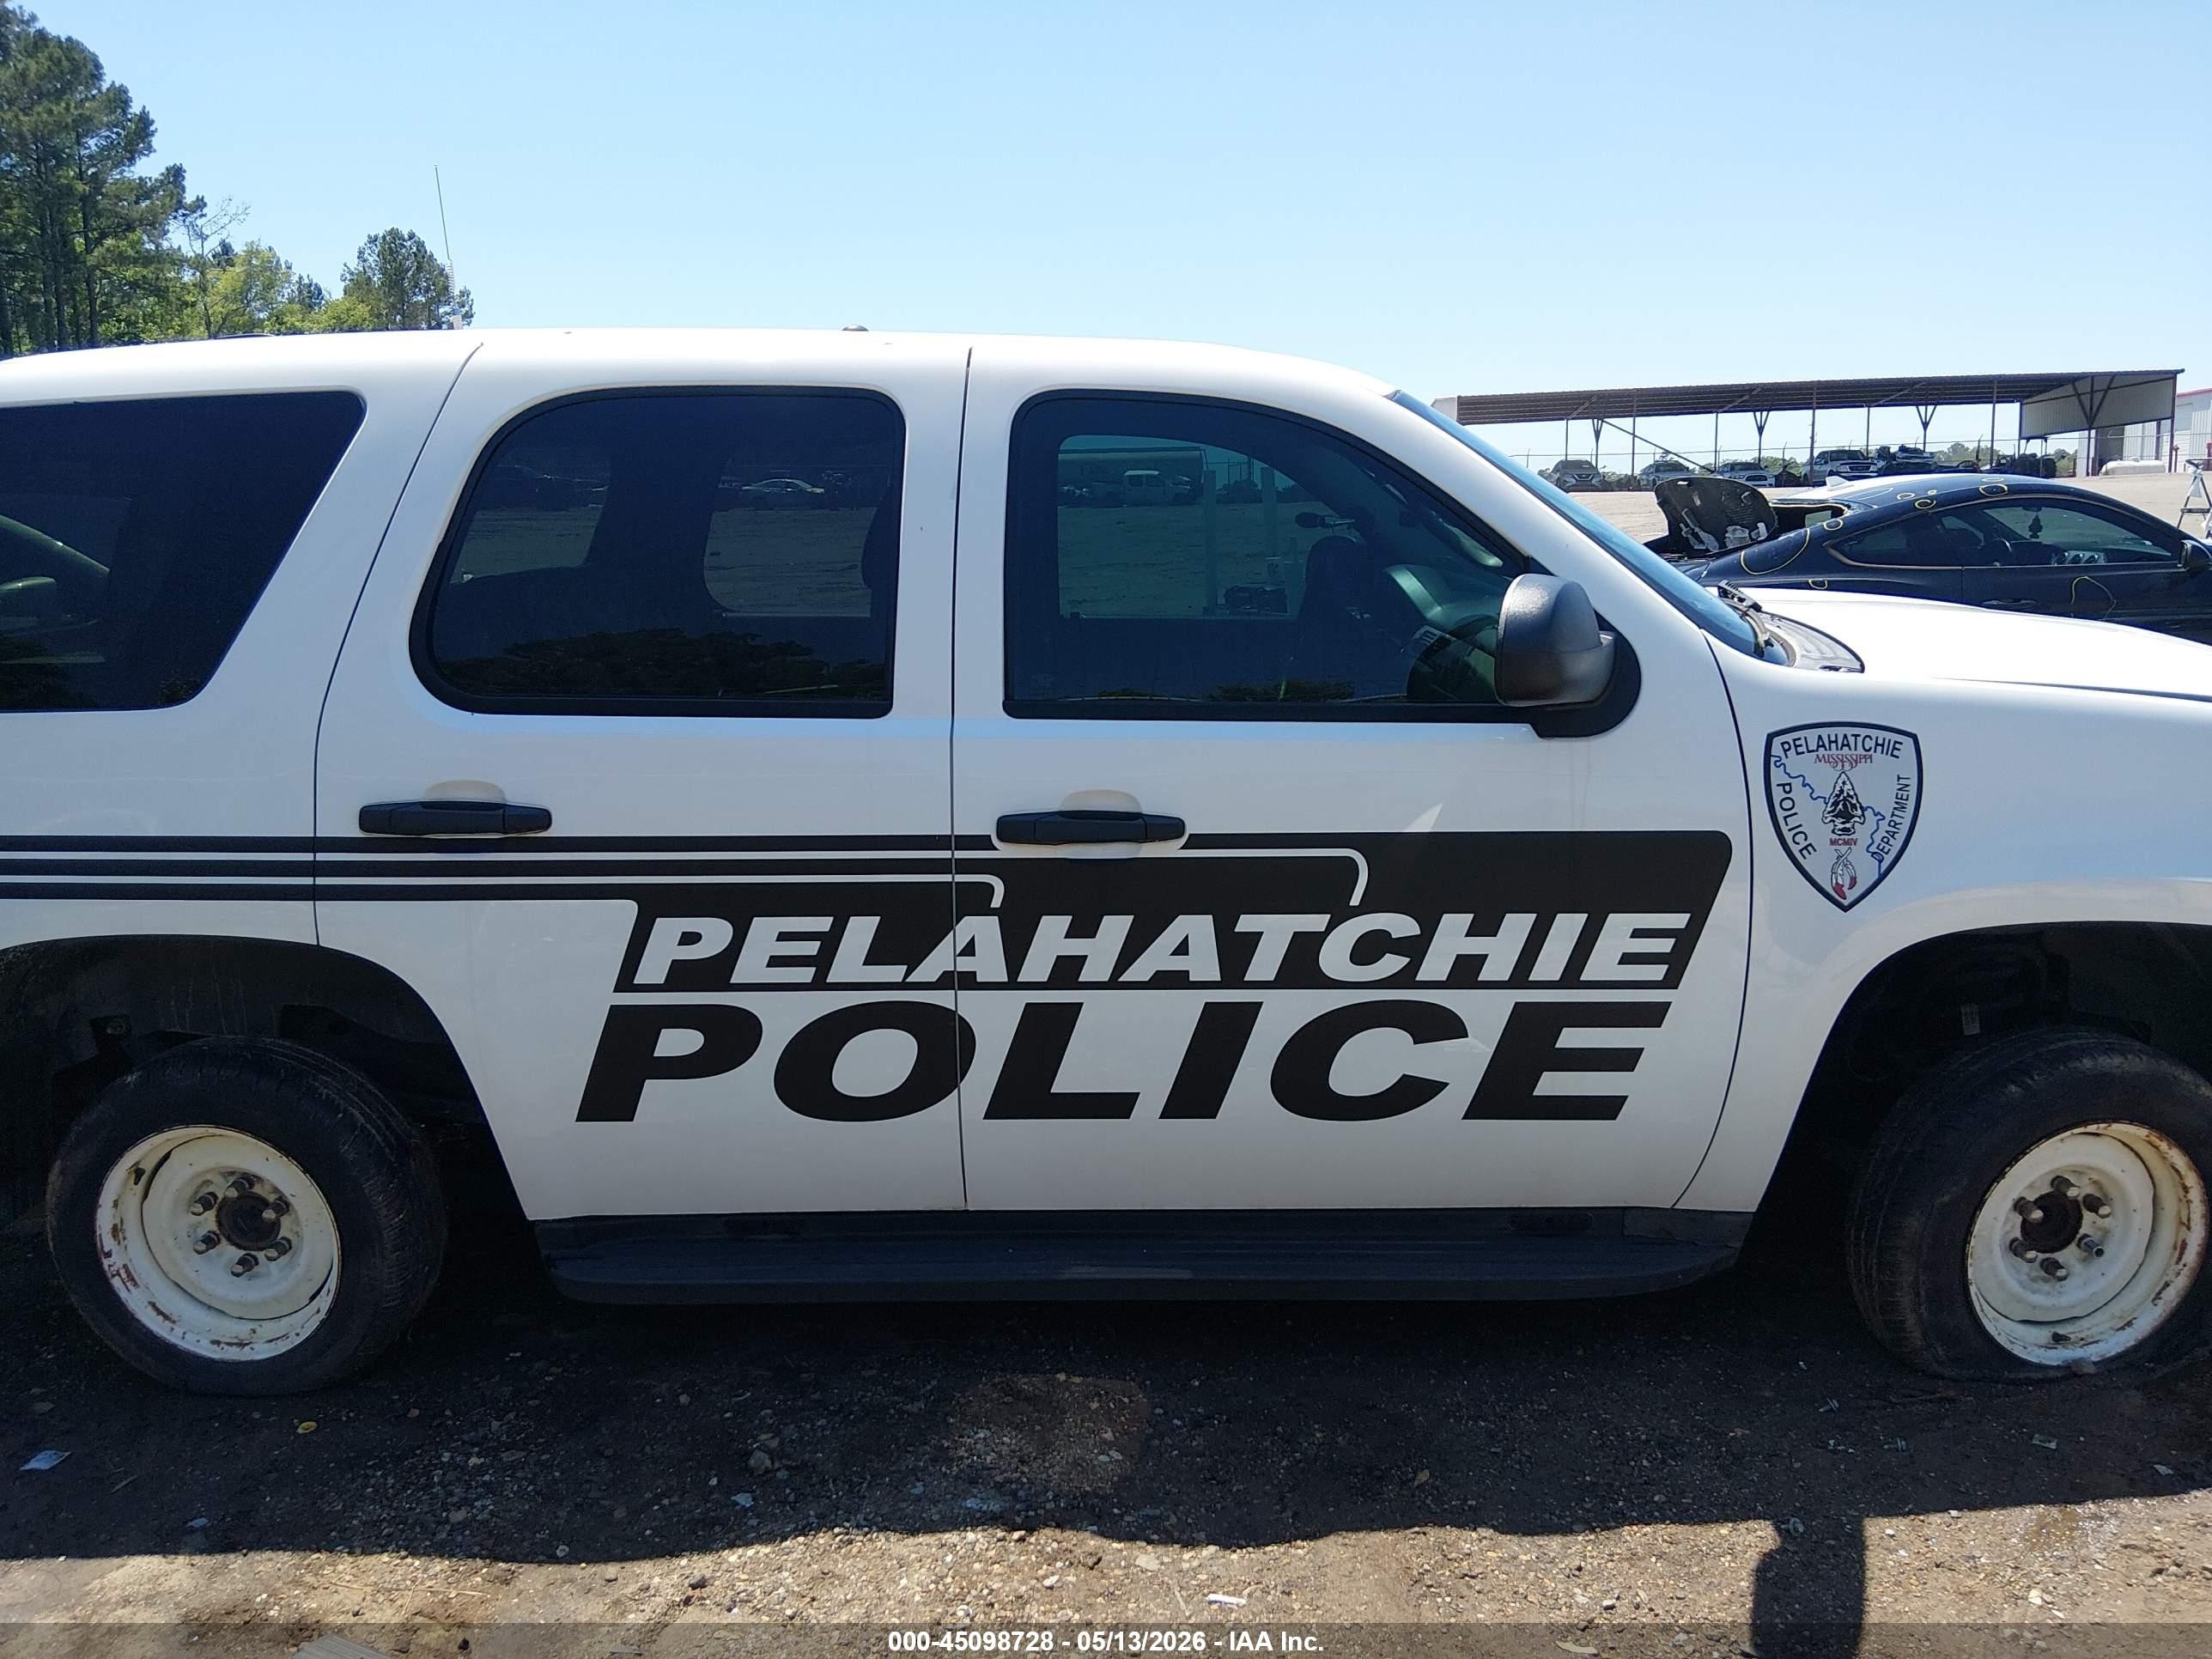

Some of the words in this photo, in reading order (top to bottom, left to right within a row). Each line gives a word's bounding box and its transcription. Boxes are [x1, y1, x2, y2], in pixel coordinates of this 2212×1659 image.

[1780, 733, 1904, 759] PELAHATCHIE
[1814, 754, 1873, 771] MISSISSIPPI
[1777, 782, 1817, 860] POLICE
[1871, 775, 1911, 863] DEPARTMENT
[632, 913, 1691, 985] PELAHATCHIE
[574, 999, 1672, 1123] POLICE
